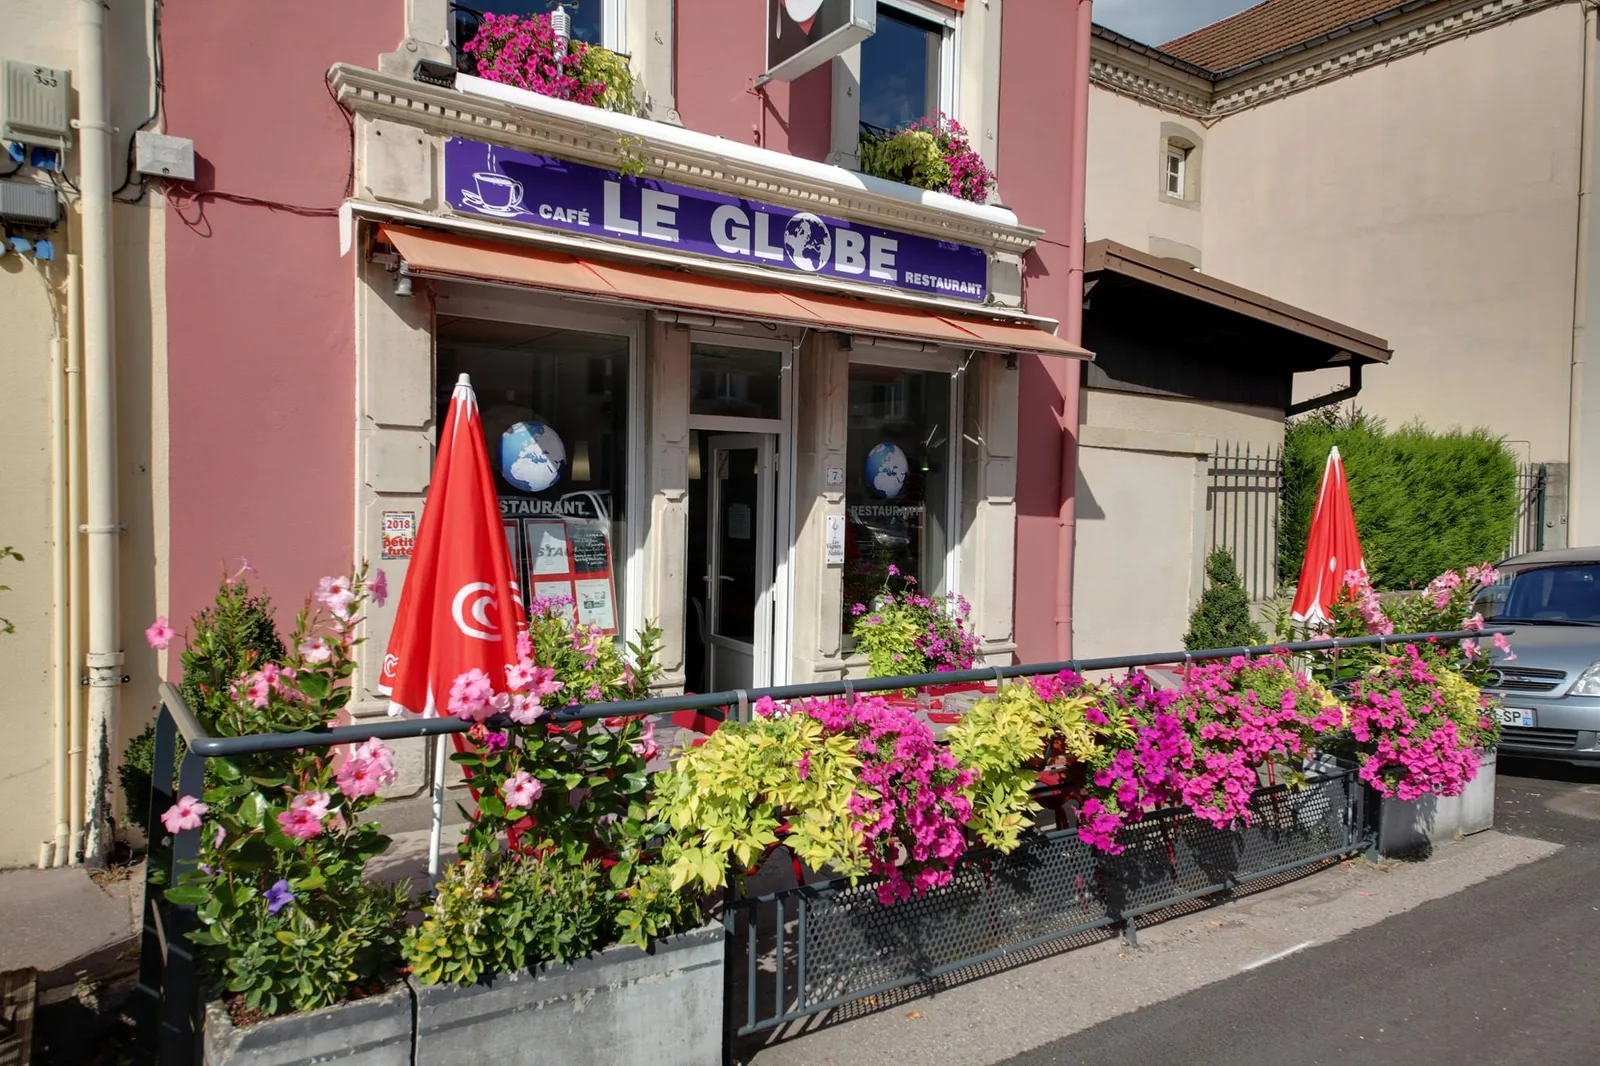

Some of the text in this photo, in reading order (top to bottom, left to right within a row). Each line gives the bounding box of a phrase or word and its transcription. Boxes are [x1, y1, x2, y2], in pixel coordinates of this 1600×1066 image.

[539, 179, 982, 295] CAFÉ LE GLOBE RESTAURANT
[499, 499, 586, 514] STAURANT
[851, 505, 920, 516] RESTAURANT
[386, 519, 411, 529] 2018
[382, 537, 413, 549] petit
